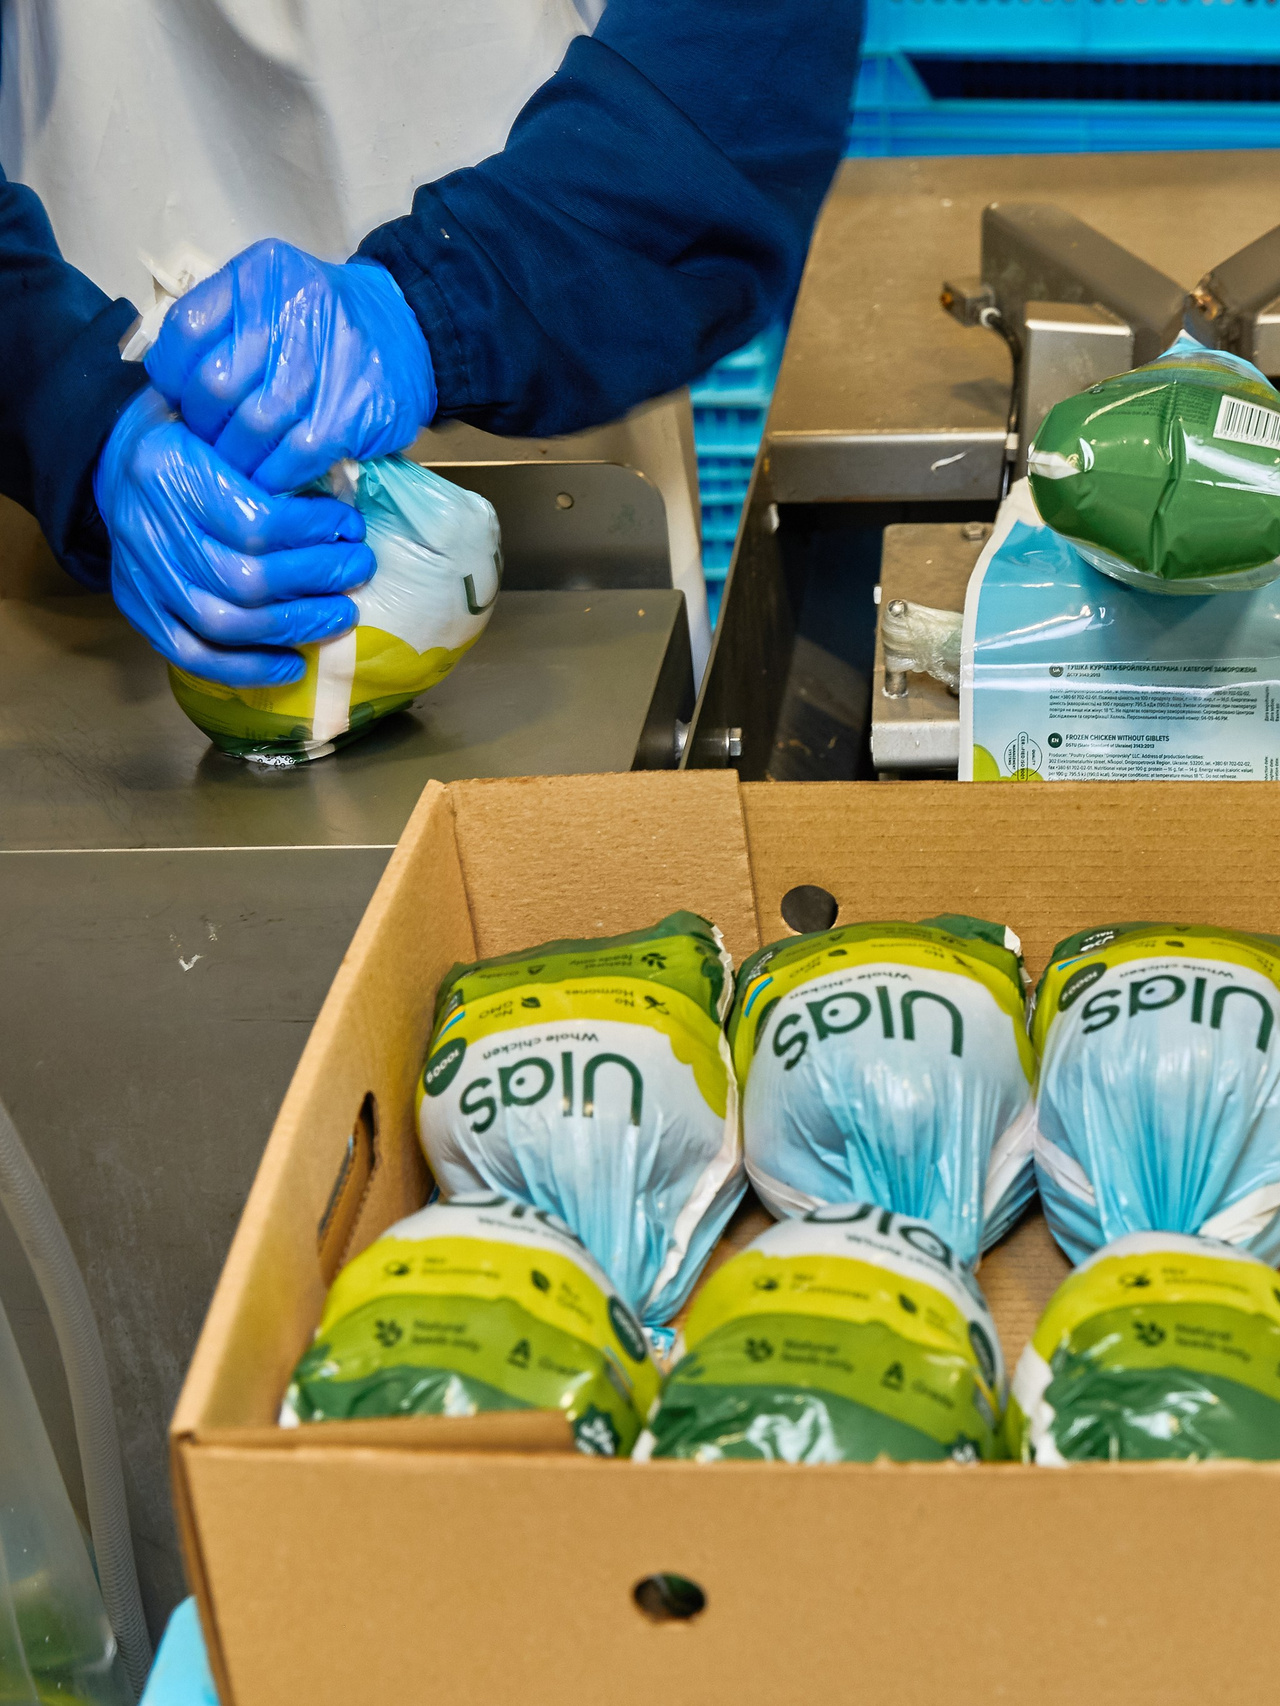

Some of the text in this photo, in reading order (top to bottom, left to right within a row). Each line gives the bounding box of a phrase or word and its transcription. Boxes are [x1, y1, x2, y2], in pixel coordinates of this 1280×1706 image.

[1090, 664, 1150, 672] КУРЧАТИ-БРОЙЛЕРА
[1151, 665, 1179, 673] ПАТРАНА
[1066, 733, 1089, 741] FROZEN
[1117, 734, 1144, 742] WITHOUT
[1182, 963, 1234, 979] Whole
[788, 970, 912, 1000] Whole chicken
[564, 988, 635, 1000] Hormones
[614, 997, 635, 1008] No
[494, 1009, 513, 1019] No
[1080, 976, 1275, 1053] Ulas
[773, 985, 963, 1072] Ulas
[482, 1031, 599, 1061] Whole chicken
[459, 1051, 644, 1134] Ulas
